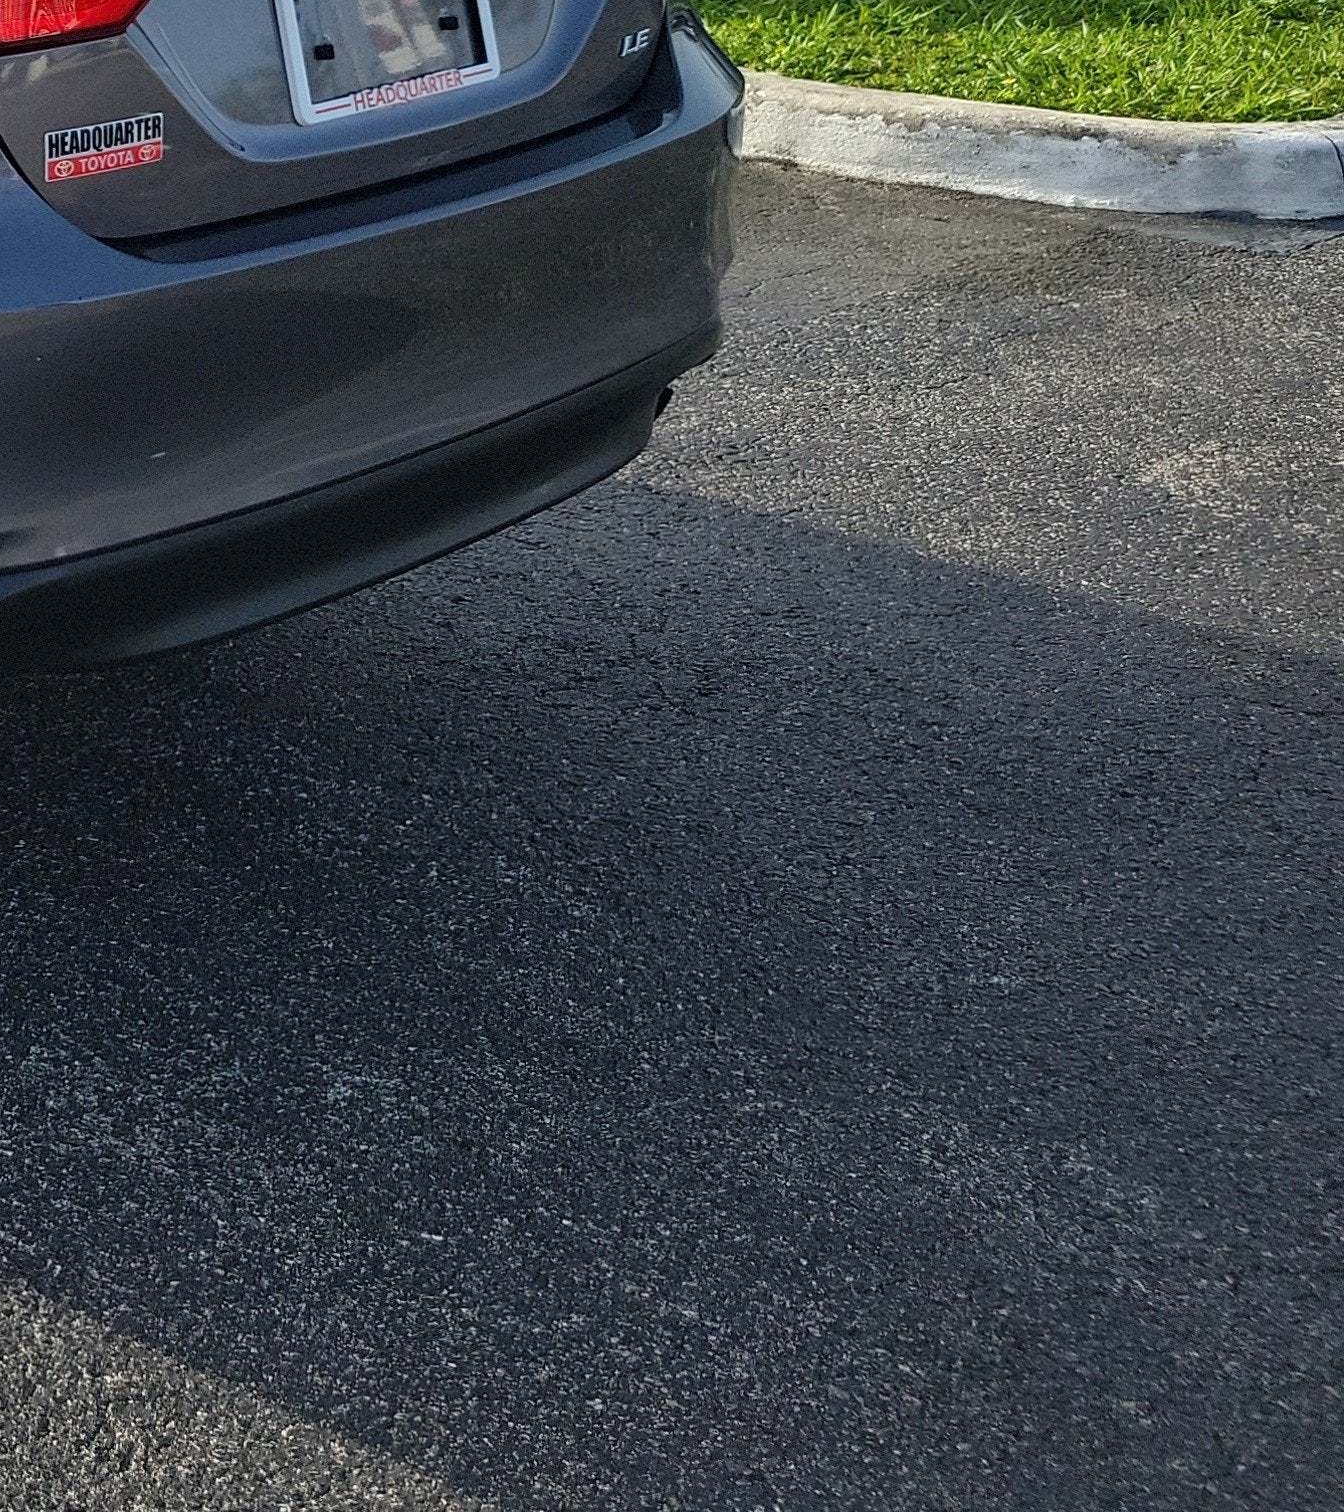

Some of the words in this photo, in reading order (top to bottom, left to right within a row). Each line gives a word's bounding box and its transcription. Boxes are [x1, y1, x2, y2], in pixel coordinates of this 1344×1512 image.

[620, 27, 651, 57] LE
[353, 69, 463, 112] HEADQUARTER
[48, 115, 162, 159] HEADQUARTER
[79, 150, 135, 173] TOYOTA
